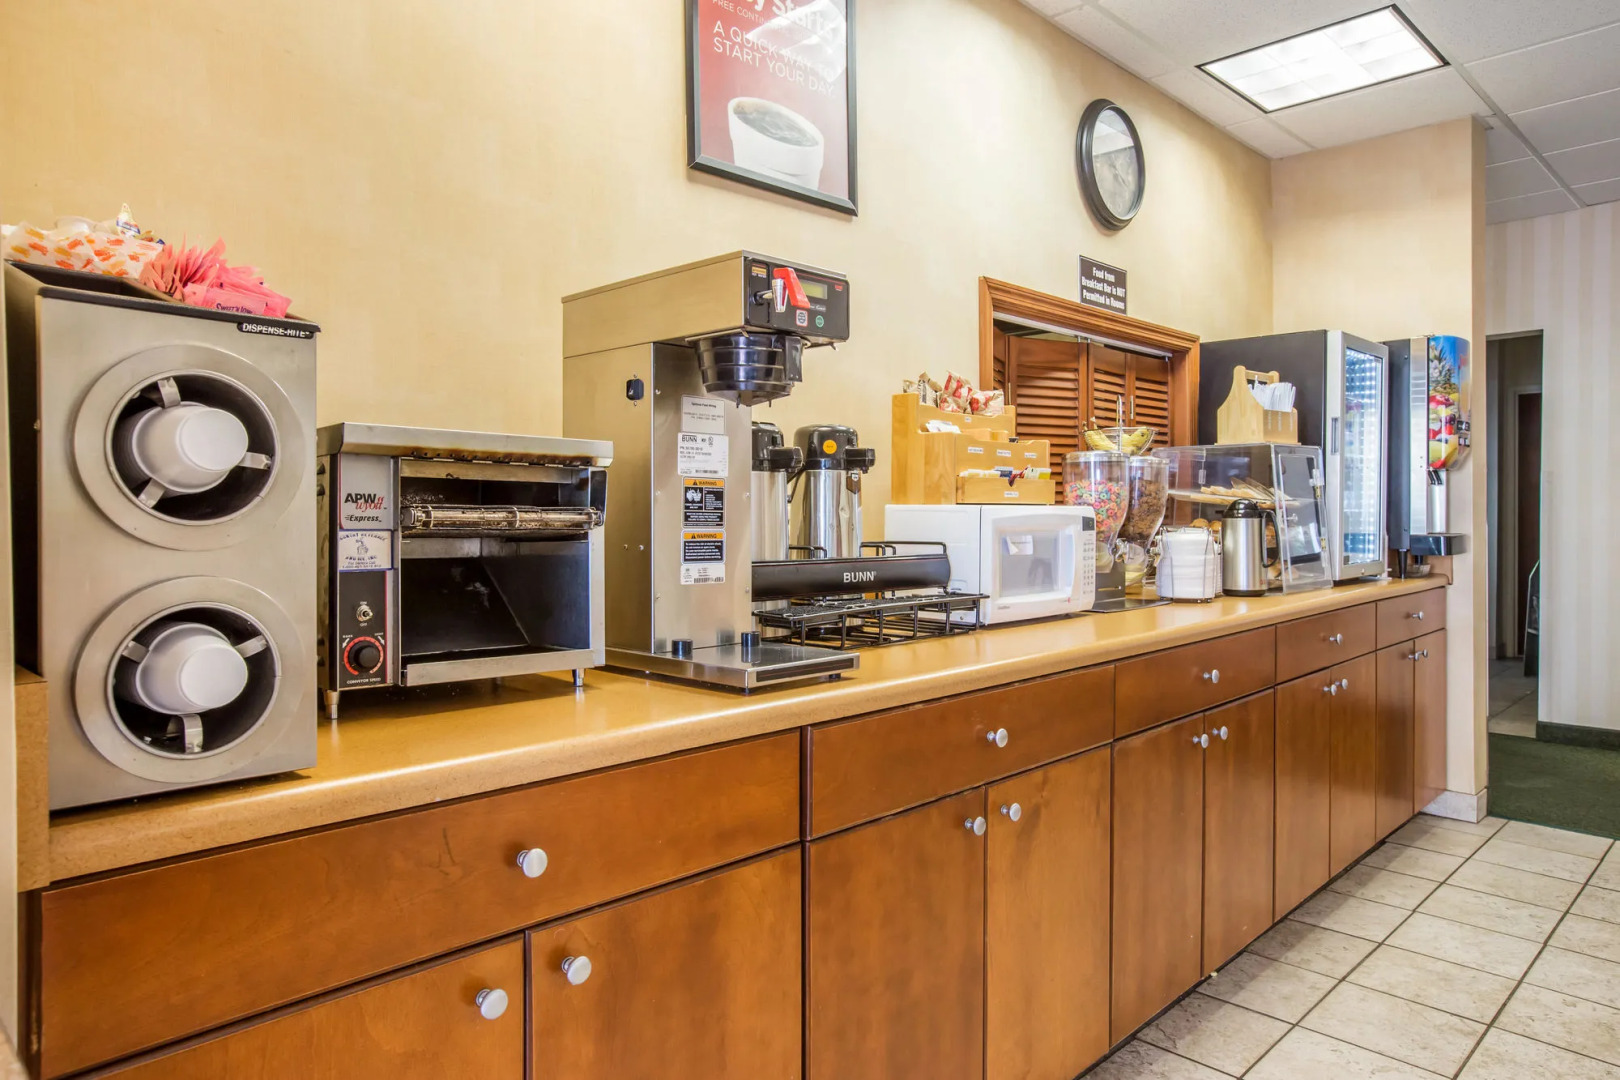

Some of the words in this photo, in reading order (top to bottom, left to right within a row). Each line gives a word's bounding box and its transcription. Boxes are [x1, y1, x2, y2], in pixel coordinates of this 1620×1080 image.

[713, 20, 725, 37] A
[730, 26, 778, 58] QUICK
[713, 37, 761, 67] START
[767, 57, 805, 89] YOUR
[1092, 267, 1104, 279] Food
[1105, 271, 1115, 283] from
[1081, 276, 1104, 291] Breakfast
[1104, 282, 1112, 294] Bar
[1112, 285, 1117, 295] is
[1116, 287, 1126, 298] NOT
[1083, 289, 1105, 304] Permitted
[1105, 295, 1110, 305] in
[1110, 297, 1125, 310] Rooms
[681, 434, 698, 443] BUNN
[344, 492, 377, 504] APW
[349, 514, 380, 523] Express
[843, 570, 874, 583] BUNN
